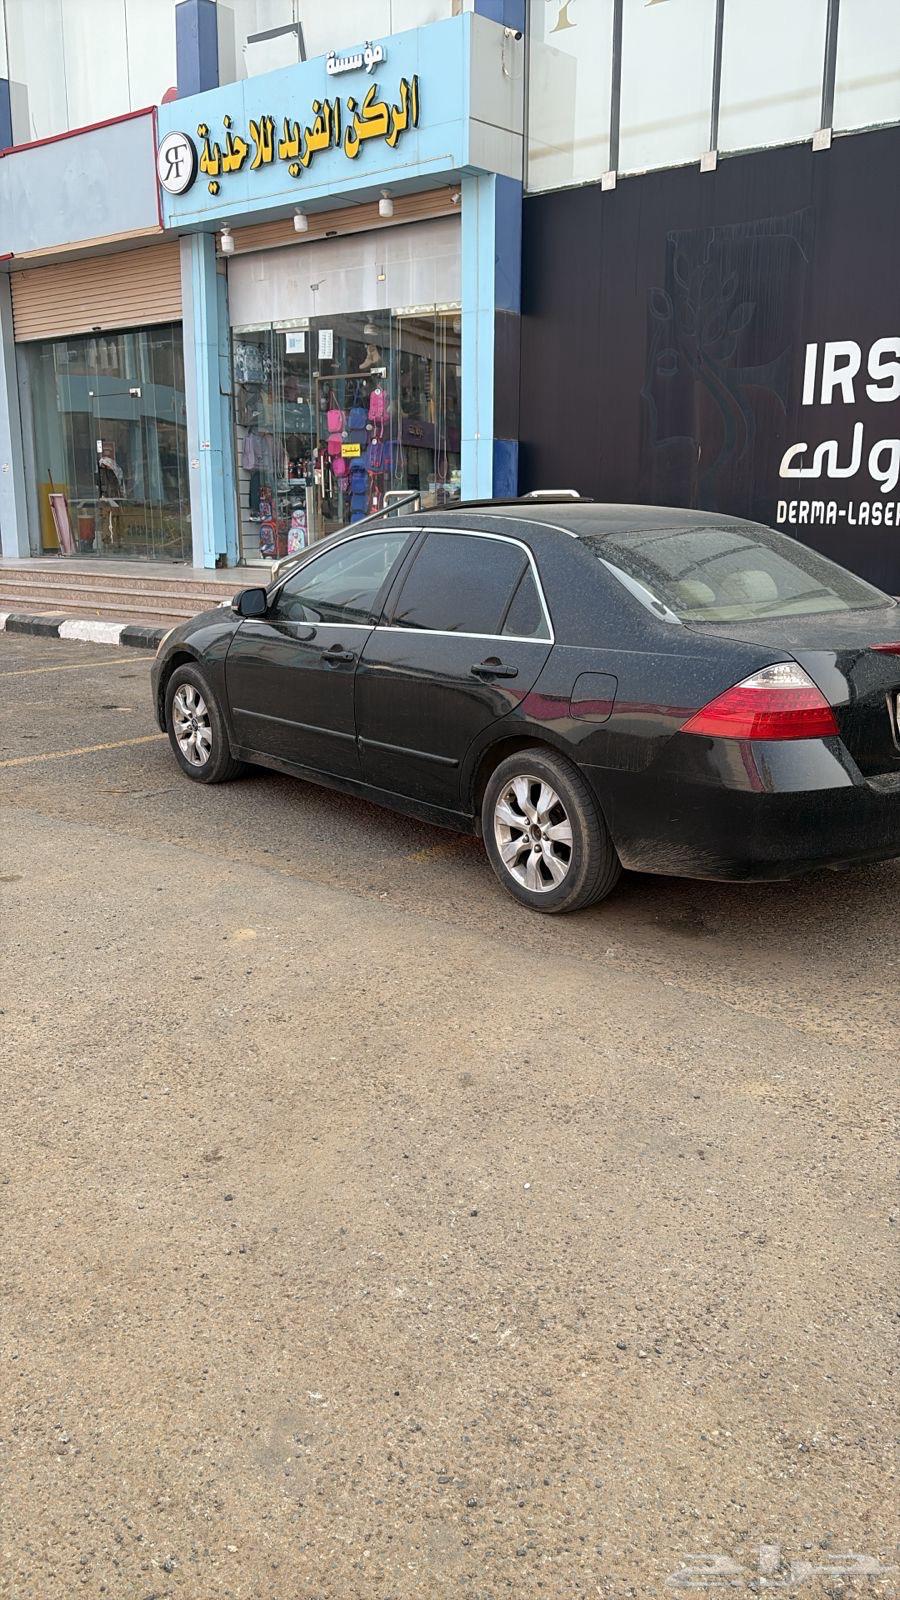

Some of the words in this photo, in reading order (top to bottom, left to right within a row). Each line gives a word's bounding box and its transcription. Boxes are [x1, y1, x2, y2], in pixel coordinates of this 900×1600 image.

[326, 40, 386, 75] مؤسسة
[197, 114, 277, 195] للاحذية
[278, 97, 342, 178] الفريد
[344, 75, 419, 160] الركن
